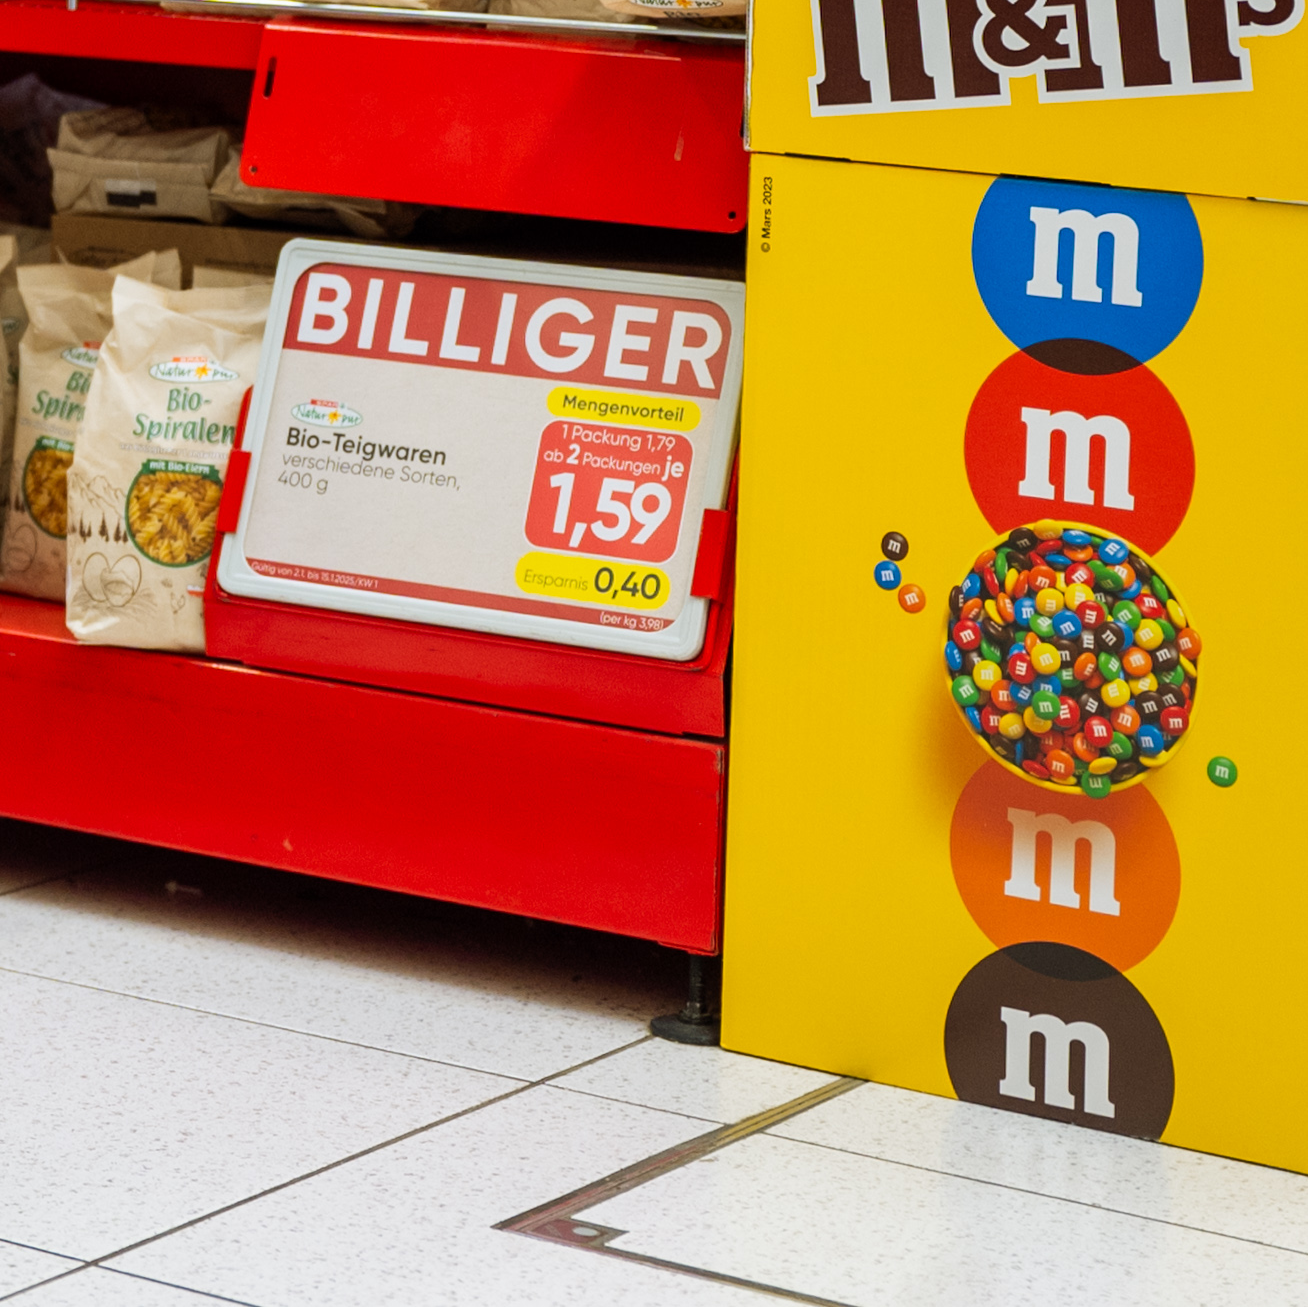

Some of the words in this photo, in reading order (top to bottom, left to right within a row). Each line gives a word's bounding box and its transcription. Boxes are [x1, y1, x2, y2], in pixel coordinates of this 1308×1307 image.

[762, 176, 773, 205] 2023
[761, 208, 772, 239] Mars
[1027, 205, 1142, 308] m
[295, 271, 723, 391] BILLIGER
[156, 362, 195, 377] Natur
[167, 386, 212, 413] Bio-
[296, 405, 327, 421] Natur
[341, 413, 360, 425] pur
[562, 394, 685, 423] Mengenvorteil
[133, 412, 236, 445] Spiralen
[562, 423, 568, 439] 1
[571, 424, 642, 452] Packung
[646, 433, 676, 453] 1,79
[286, 426, 447, 466] Bio-Teigwaren
[543, 448, 564, 463] ab
[566, 443, 581, 465] 2
[582, 452, 661, 477] Packungen
[662, 455, 685, 481] je
[1019, 406, 1134, 512] m
[149, 460, 166, 470] mit
[282, 453, 396, 480] verschiedene
[399, 465, 461, 492] Sorten,
[277, 470, 313, 489] 400
[316, 477, 329, 495] g
[549, 472, 673, 549] 1,59
[251, 560, 276, 576] Gültig
[277, 566, 293, 576] von
[307, 571, 320, 581] bis
[523, 568, 589, 592] Ersparnis
[593, 566, 662, 601] 0,40
[599, 610, 621, 625] (per
[623, 613, 637, 630] kg
[638, 616, 664, 631] 3,98)
[1004, 808, 1120, 917] m
[999, 1006, 1115, 1118] m
